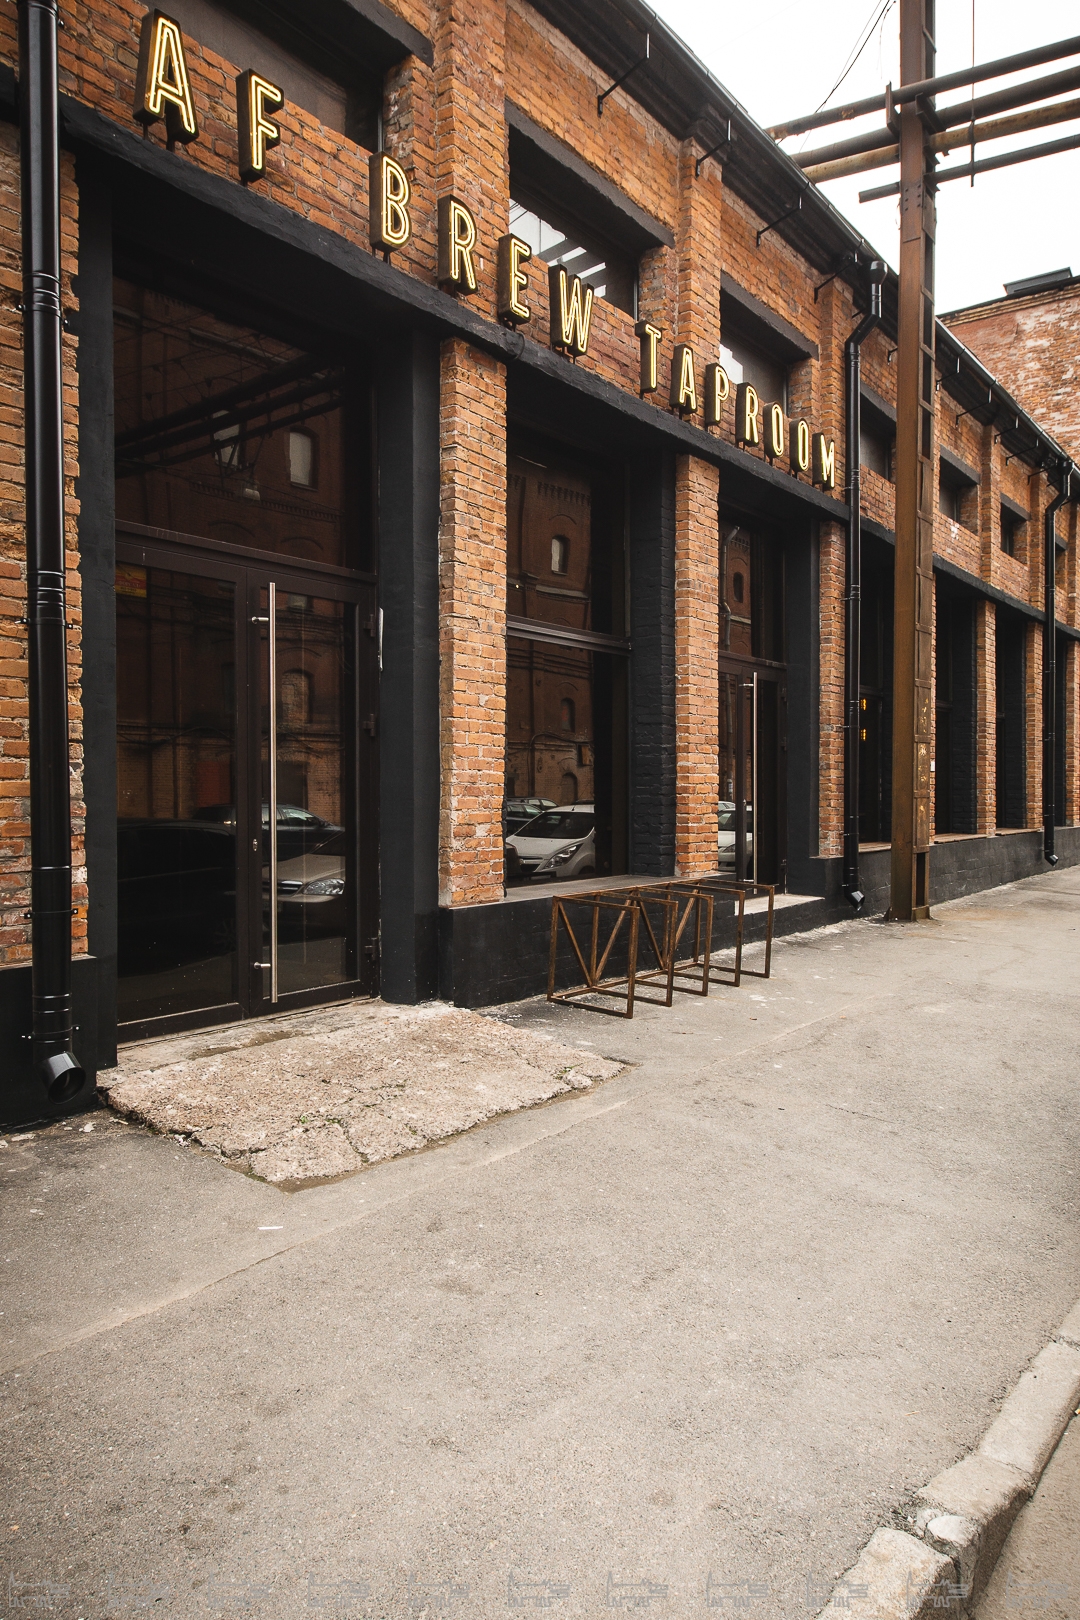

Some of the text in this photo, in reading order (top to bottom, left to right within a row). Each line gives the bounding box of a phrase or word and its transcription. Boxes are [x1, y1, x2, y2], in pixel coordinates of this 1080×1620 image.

[135, 9, 836, 490] AF BREW TAPROOM
